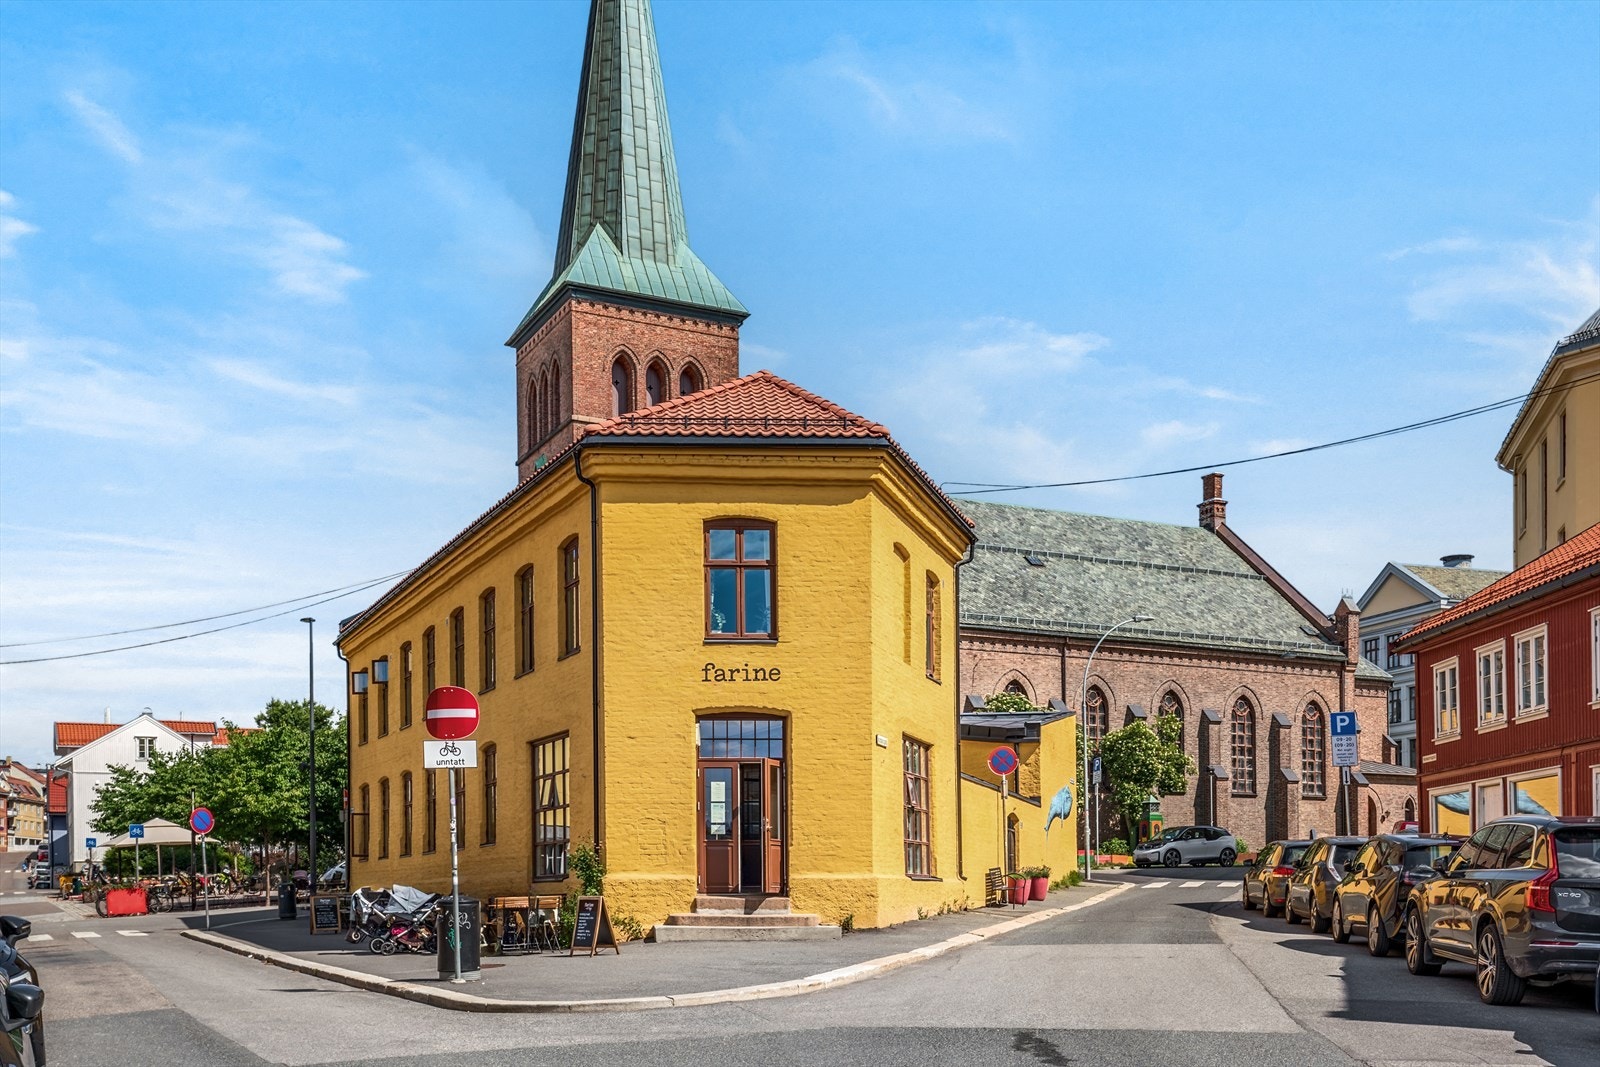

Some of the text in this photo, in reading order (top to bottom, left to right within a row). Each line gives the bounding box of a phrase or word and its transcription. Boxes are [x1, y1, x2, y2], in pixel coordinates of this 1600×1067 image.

[701, 662, 781, 682] farine
[1336, 715, 1350, 733] P
[436, 758, 466, 766] unntatt
[1095, 760, 1099, 770] P
